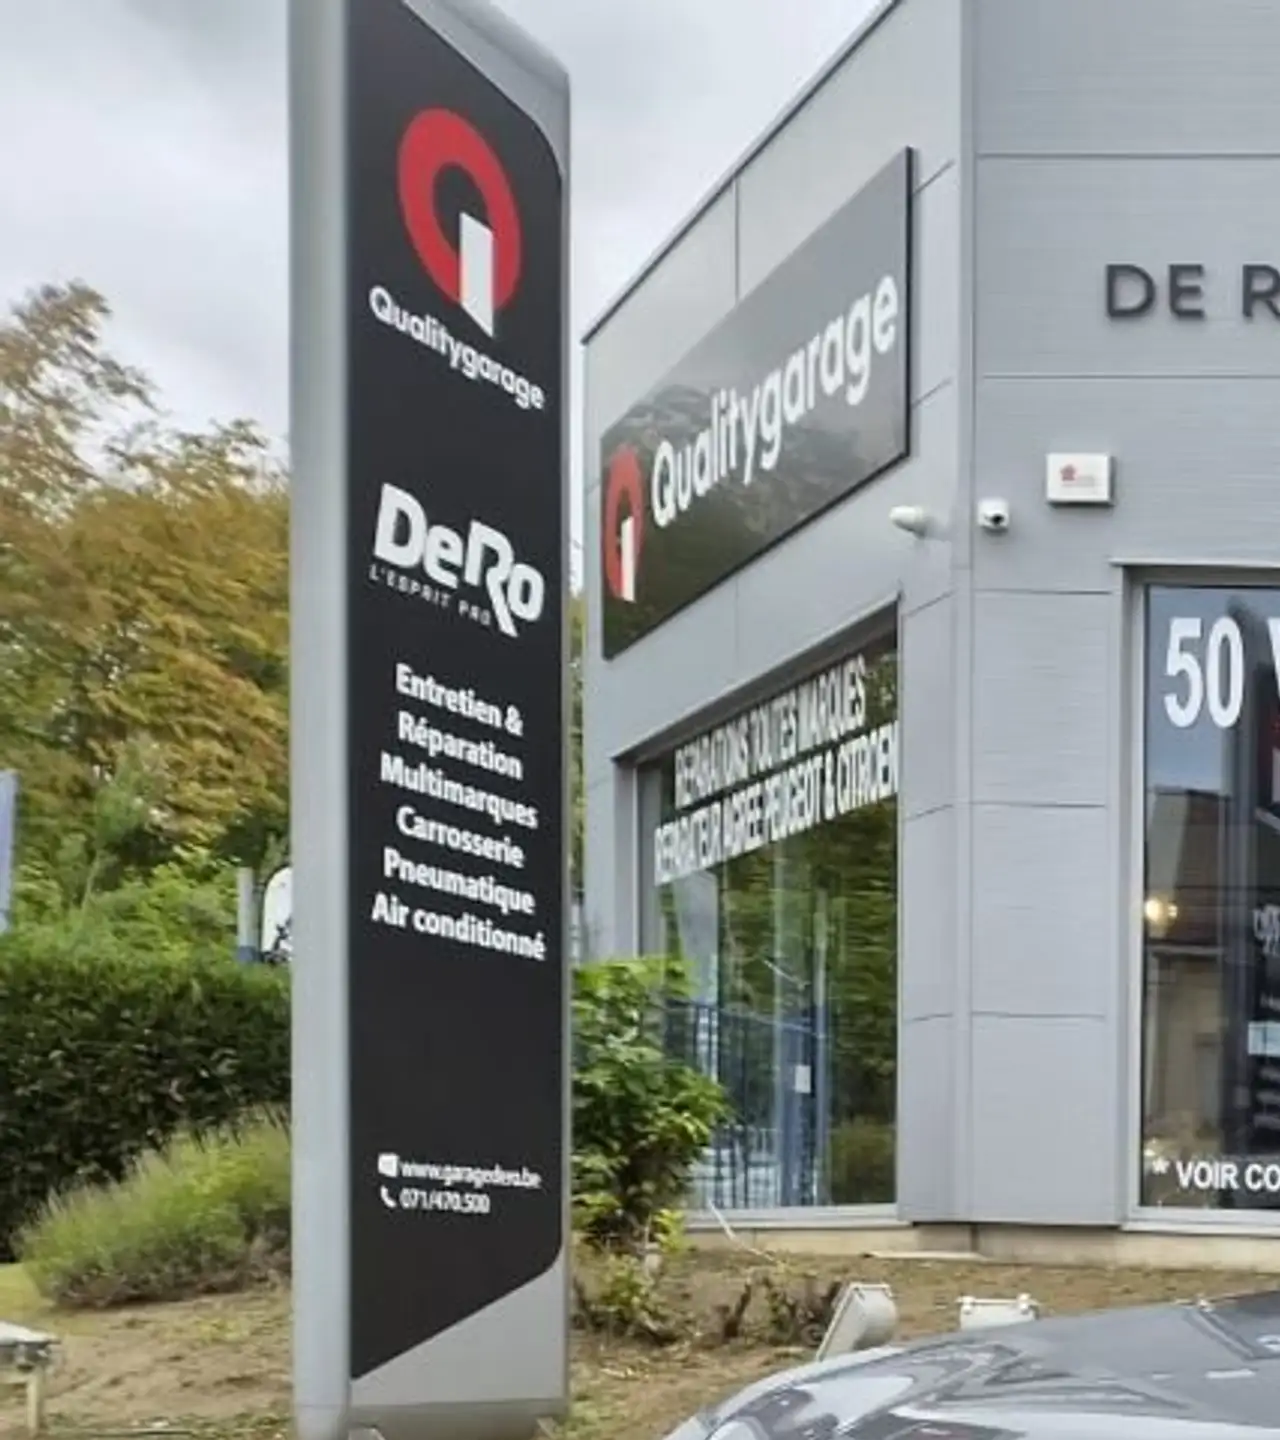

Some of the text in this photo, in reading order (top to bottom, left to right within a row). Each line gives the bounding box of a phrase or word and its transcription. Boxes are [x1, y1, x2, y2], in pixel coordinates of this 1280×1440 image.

[1105, 263, 1206, 319] DE
[368, 284, 546, 410] Qualitygarage
[651, 275, 898, 528] Qualitygarage
[395, 661, 525, 738] Entretien &
[1164, 615, 1245, 729] 50
[397, 709, 524, 781] Réparation
[380, 750, 539, 830] Multimarques
[395, 805, 526, 869] Carrosserie
[383, 845, 537, 916] Pneumatique
[371, 890, 548, 962] Air conditionné
[1176, 1162, 1240, 1192] VOIR
